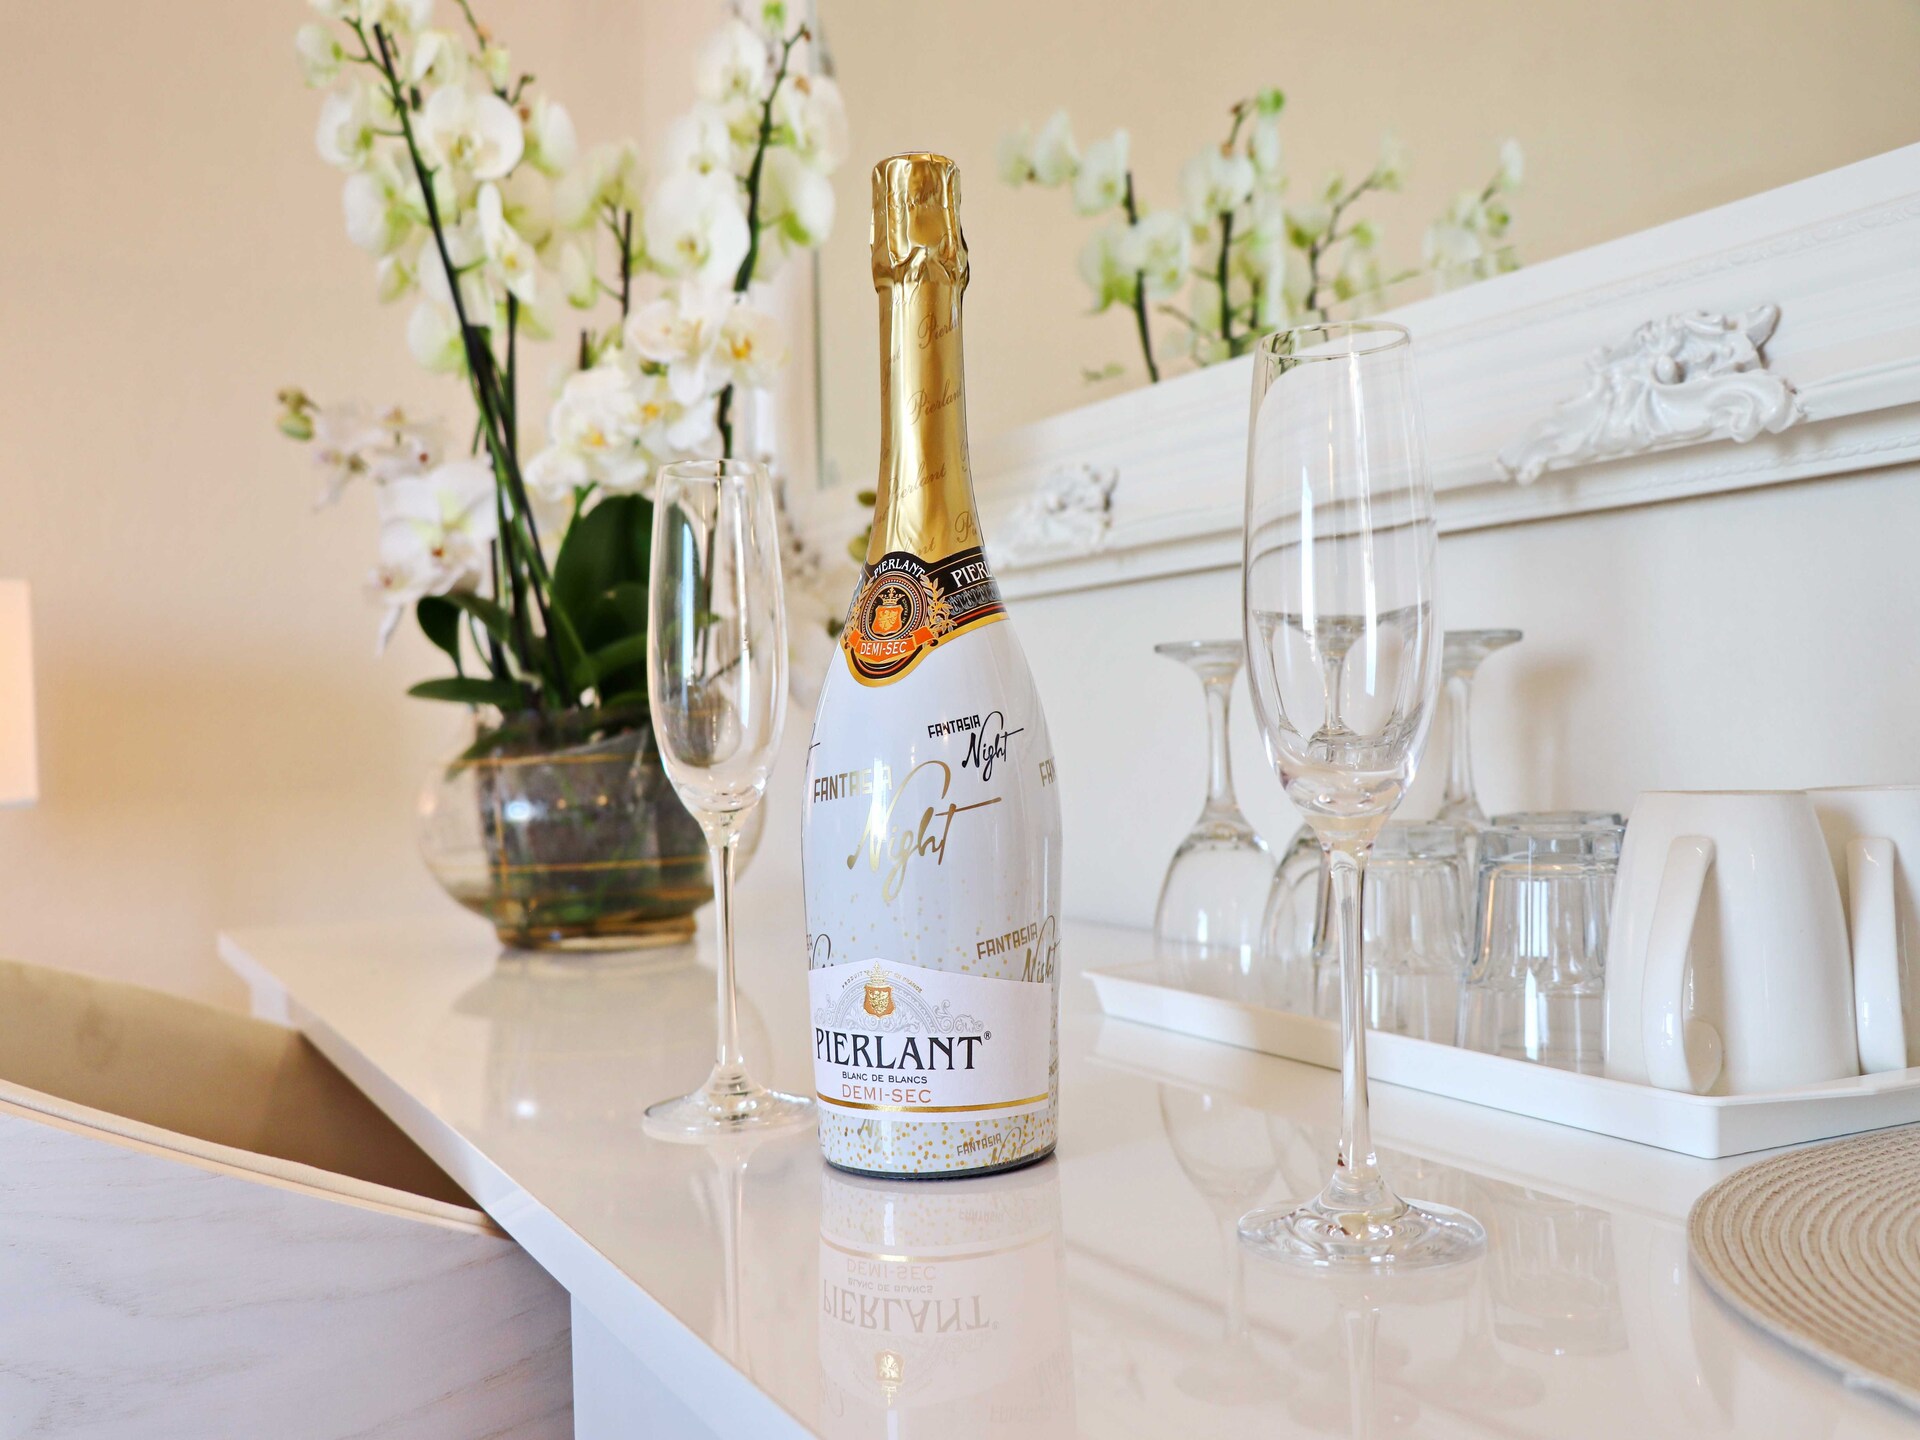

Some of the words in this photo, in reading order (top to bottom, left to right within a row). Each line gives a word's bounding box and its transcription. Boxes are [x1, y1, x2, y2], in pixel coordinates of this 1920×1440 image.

[874, 558, 926, 579] PIERLANT
[860, 640, 908, 656] DEMI-SEC
[927, 714, 981, 739] FANTASIA
[961, 710, 1025, 782] Night
[813, 765, 893, 803] FANTASA
[846, 760, 1003, 902] Night
[976, 922, 1038, 960] FANTASIA
[842, 1071, 868, 1082] BLANC
[871, 1074, 884, 1083] DE
[888, 1075, 928, 1085] BLANCS
[842, 1083, 932, 1104] DEMI-SEC
[957, 1132, 1002, 1157] FANTASIA
